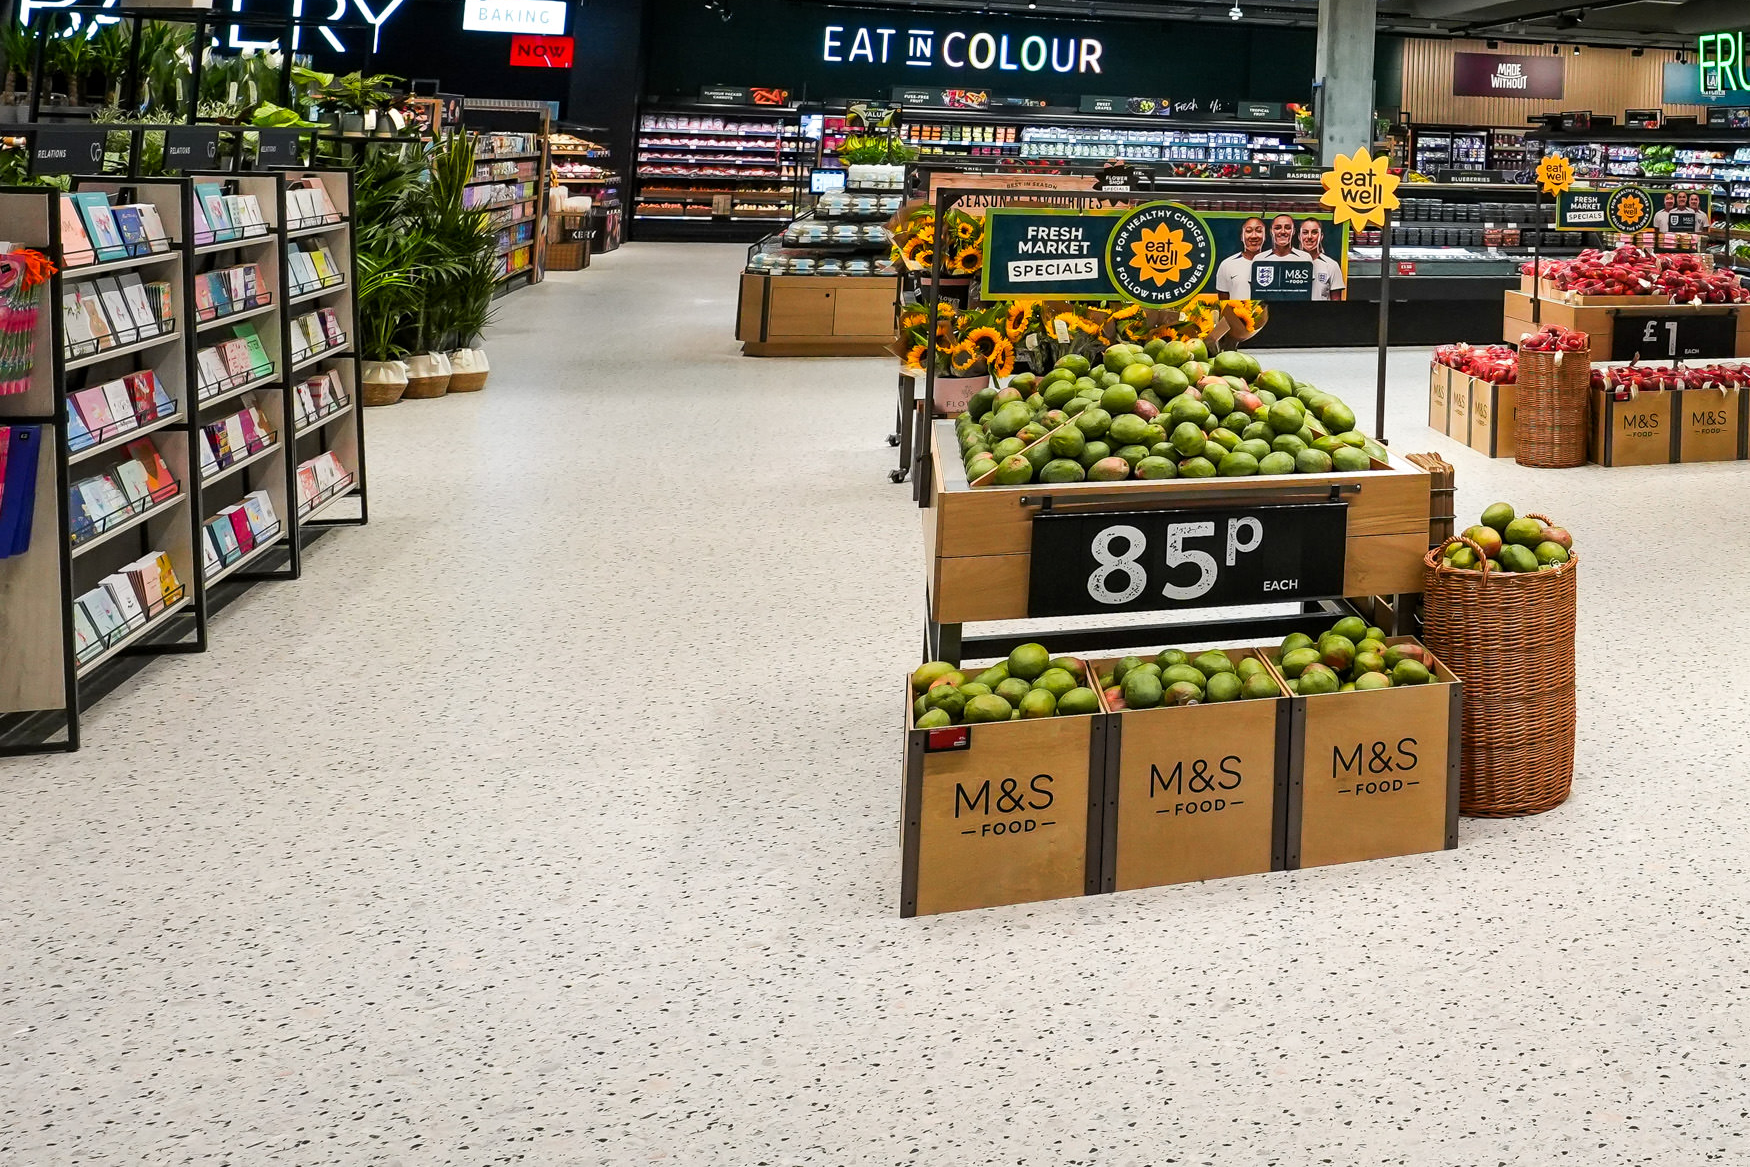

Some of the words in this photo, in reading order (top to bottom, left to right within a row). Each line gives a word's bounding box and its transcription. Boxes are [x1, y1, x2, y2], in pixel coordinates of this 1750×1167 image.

[478, 7, 550, 24] BAKING
[517, 44, 565, 58] NOW
[823, 26, 896, 63] EAT
[942, 32, 1102, 73] COLOUR
[1498, 63, 1521, 76] MADE
[1490, 74, 1528, 90] WITHOUT
[1174, 99, 1198, 112] Fresh
[37, 149, 67, 159] RELATIONS
[169, 146, 190, 155] RELATIONS
[1546, 163, 1563, 173] eat
[1546, 171, 1566, 181] well
[1340, 168, 1377, 187] eat
[1032, 182, 1057, 190] SEASON
[1340, 184, 1382, 204] well
[1027, 226, 1083, 240] FRESH
[1115, 231, 1129, 251] FOR
[1126, 210, 1173, 233] HEALTHY
[1174, 212, 1206, 248] CHOICES
[1018, 241, 1091, 255] MARKET
[1145, 238, 1173, 253] eat
[1145, 250, 1178, 266] well
[1013, 261, 1094, 278] SPECIALS
[1285, 269, 1309, 280] M&S
[1116, 267, 1150, 298] FOLLOW
[1151, 291, 1172, 300] THE
[1173, 263, 1205, 296] FLOWER
[1642, 320, 1678, 356] £1
[1434, 384, 1445, 399] M&S
[1454, 393, 1465, 409] M&S
[1475, 401, 1488, 419] M&S
[1623, 414, 1659, 430] M&S
[1693, 410, 1727, 427] M&S
[1086, 516, 1264, 605] 85p
[1262, 579, 1298, 592] EACH
[1332, 737, 1419, 779] M&S
[1149, 755, 1243, 799] M&S
[1355, 779, 1403, 796] FOOD
[954, 773, 1056, 819] M&S
[1174, 799, 1227, 816] FOOD
[981, 819, 1036, 837] FOOD
